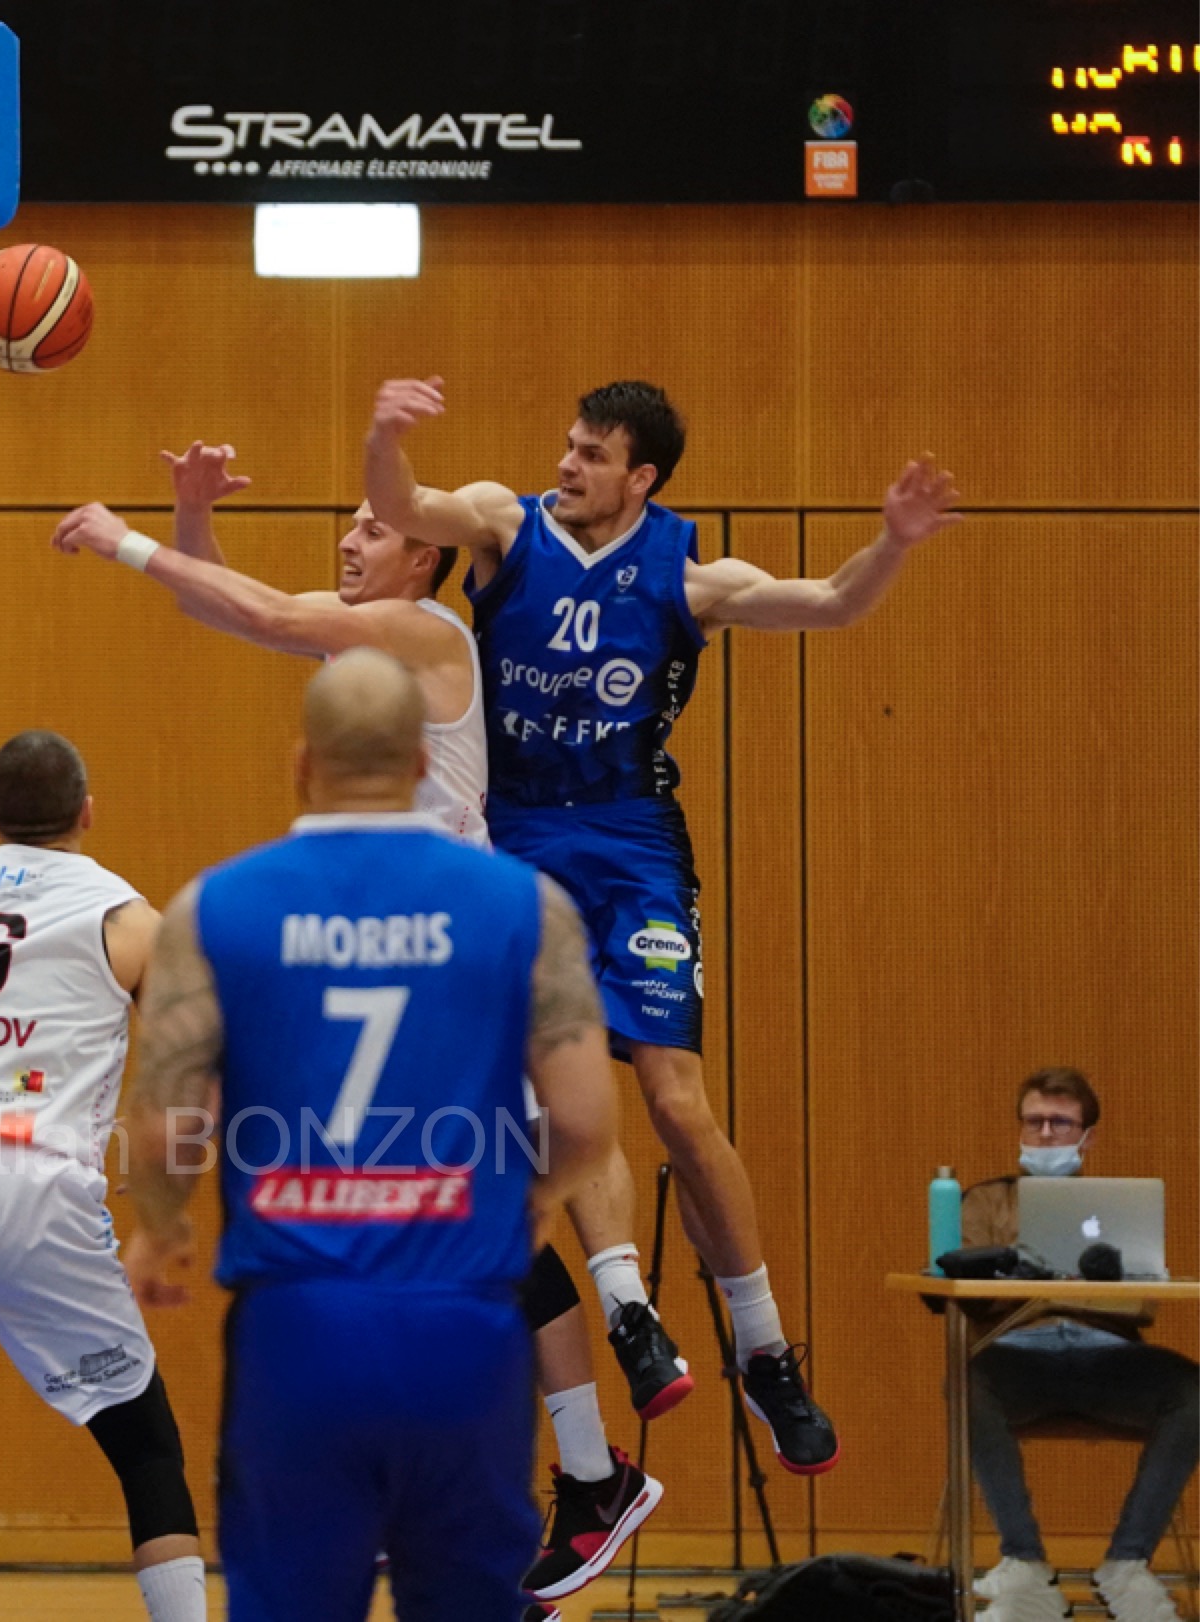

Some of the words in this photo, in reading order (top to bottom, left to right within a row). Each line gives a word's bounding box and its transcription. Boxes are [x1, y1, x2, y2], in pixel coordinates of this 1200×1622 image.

[166, 105, 582, 159] STRAMATEL
[268, 161, 362, 177] AFFICHAGE
[546, 596, 600, 652] 20
[501, 658, 593, 696] groupe
[281, 912, 453, 968] MORRIS
[324, 987, 410, 1147] 7
